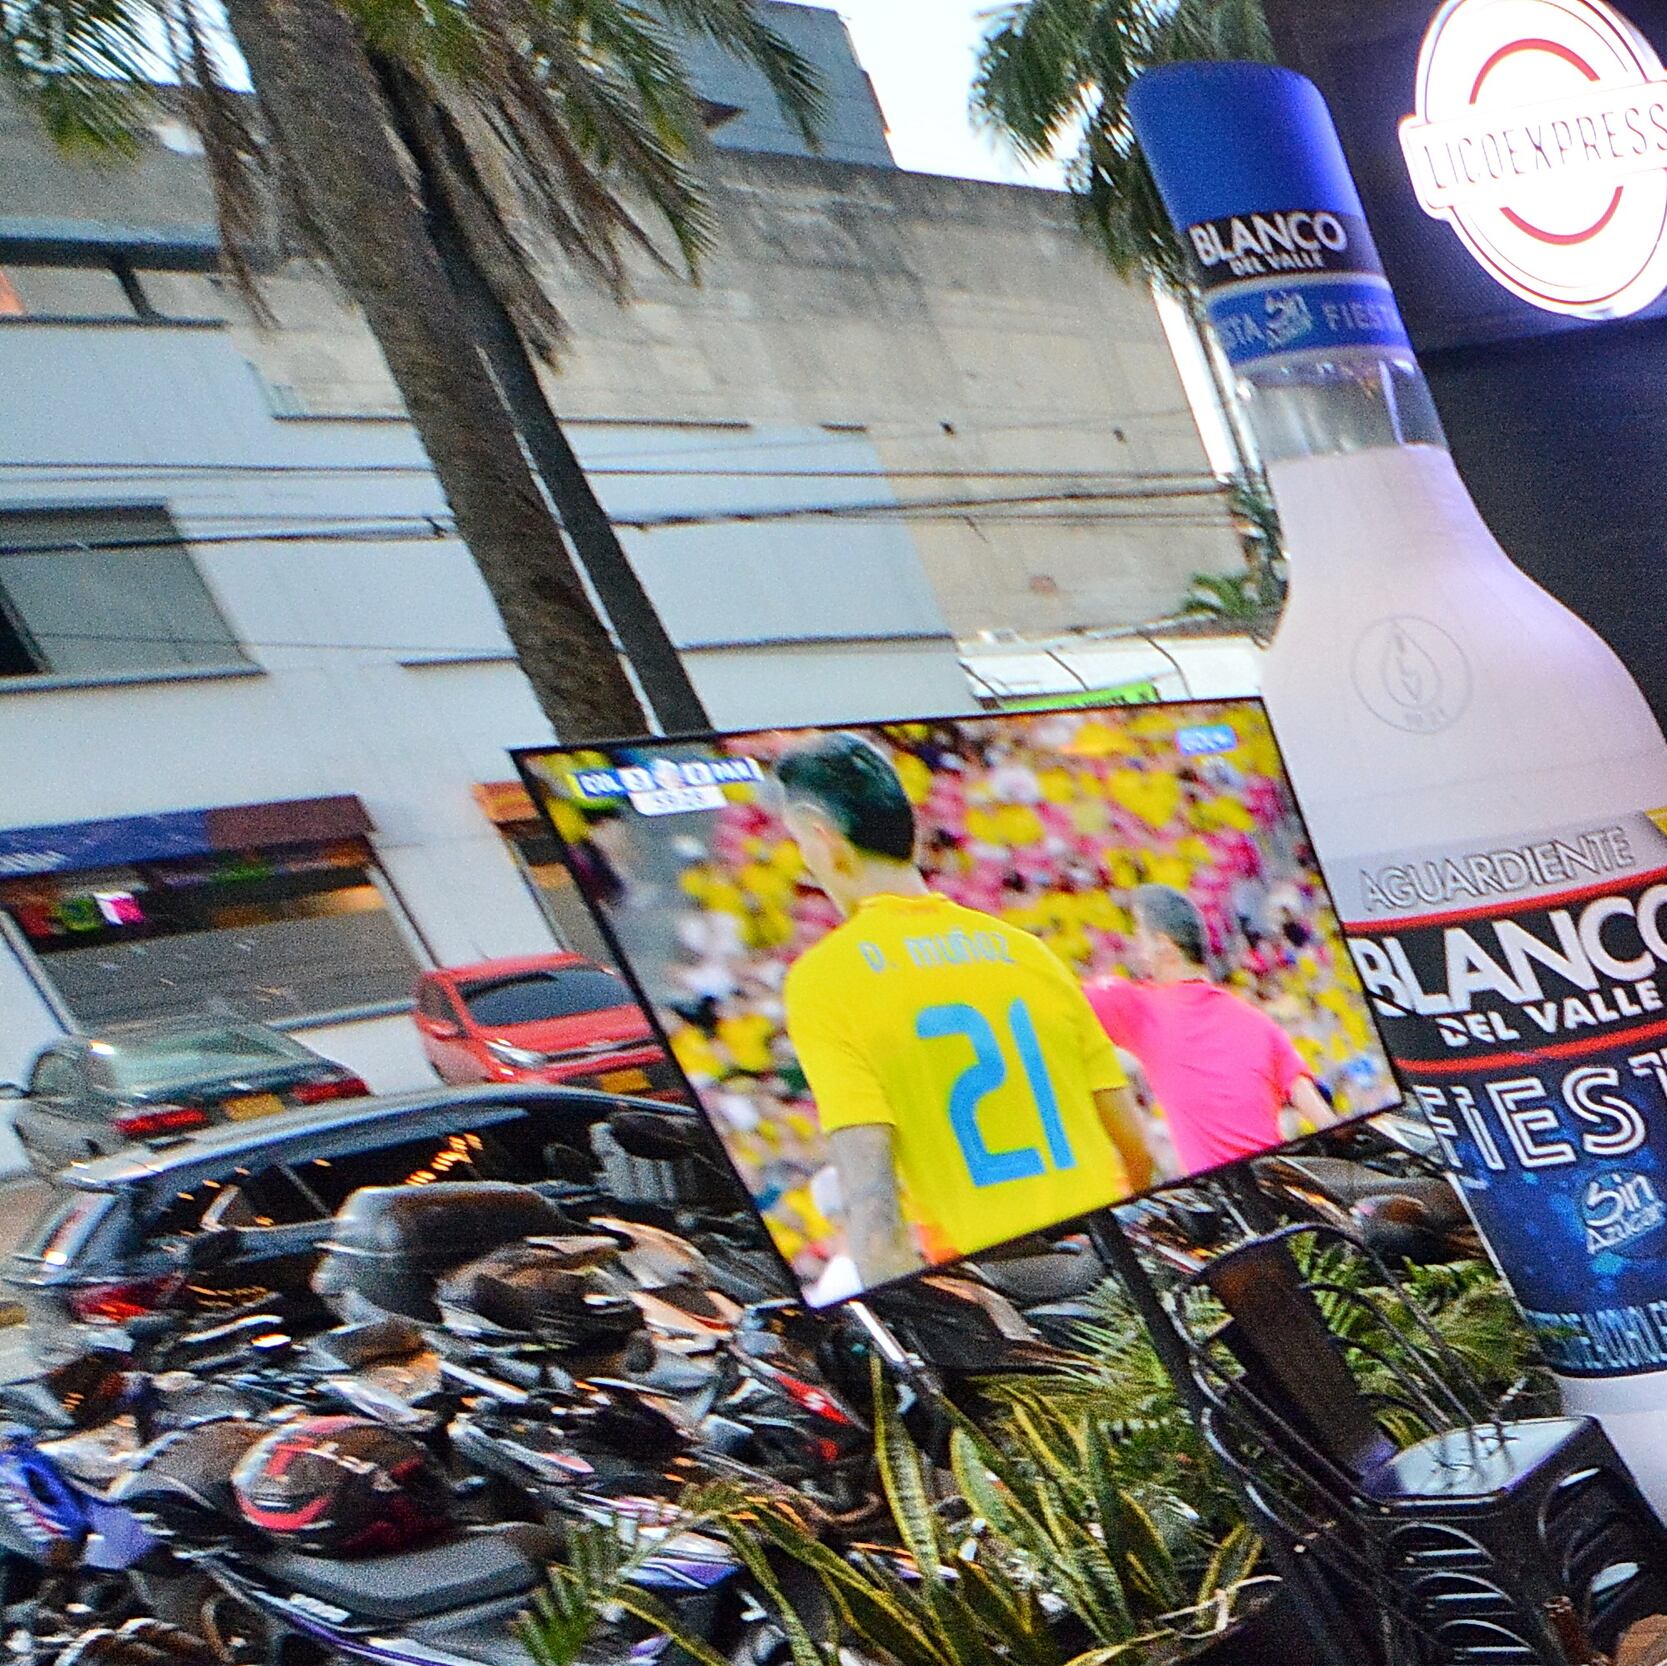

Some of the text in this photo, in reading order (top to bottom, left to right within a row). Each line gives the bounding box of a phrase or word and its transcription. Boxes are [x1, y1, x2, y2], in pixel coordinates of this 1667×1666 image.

[1189, 210, 1348, 267] BLANCO
[1229, 249, 1324, 277] DEL VALLE
[1360, 827, 1635, 912] AGUARDIENTE
[1437, 980, 1665, 1046] DEL VALLE
[914, 996, 1079, 1188] 21
[1587, 1173, 1656, 1228] Sin
